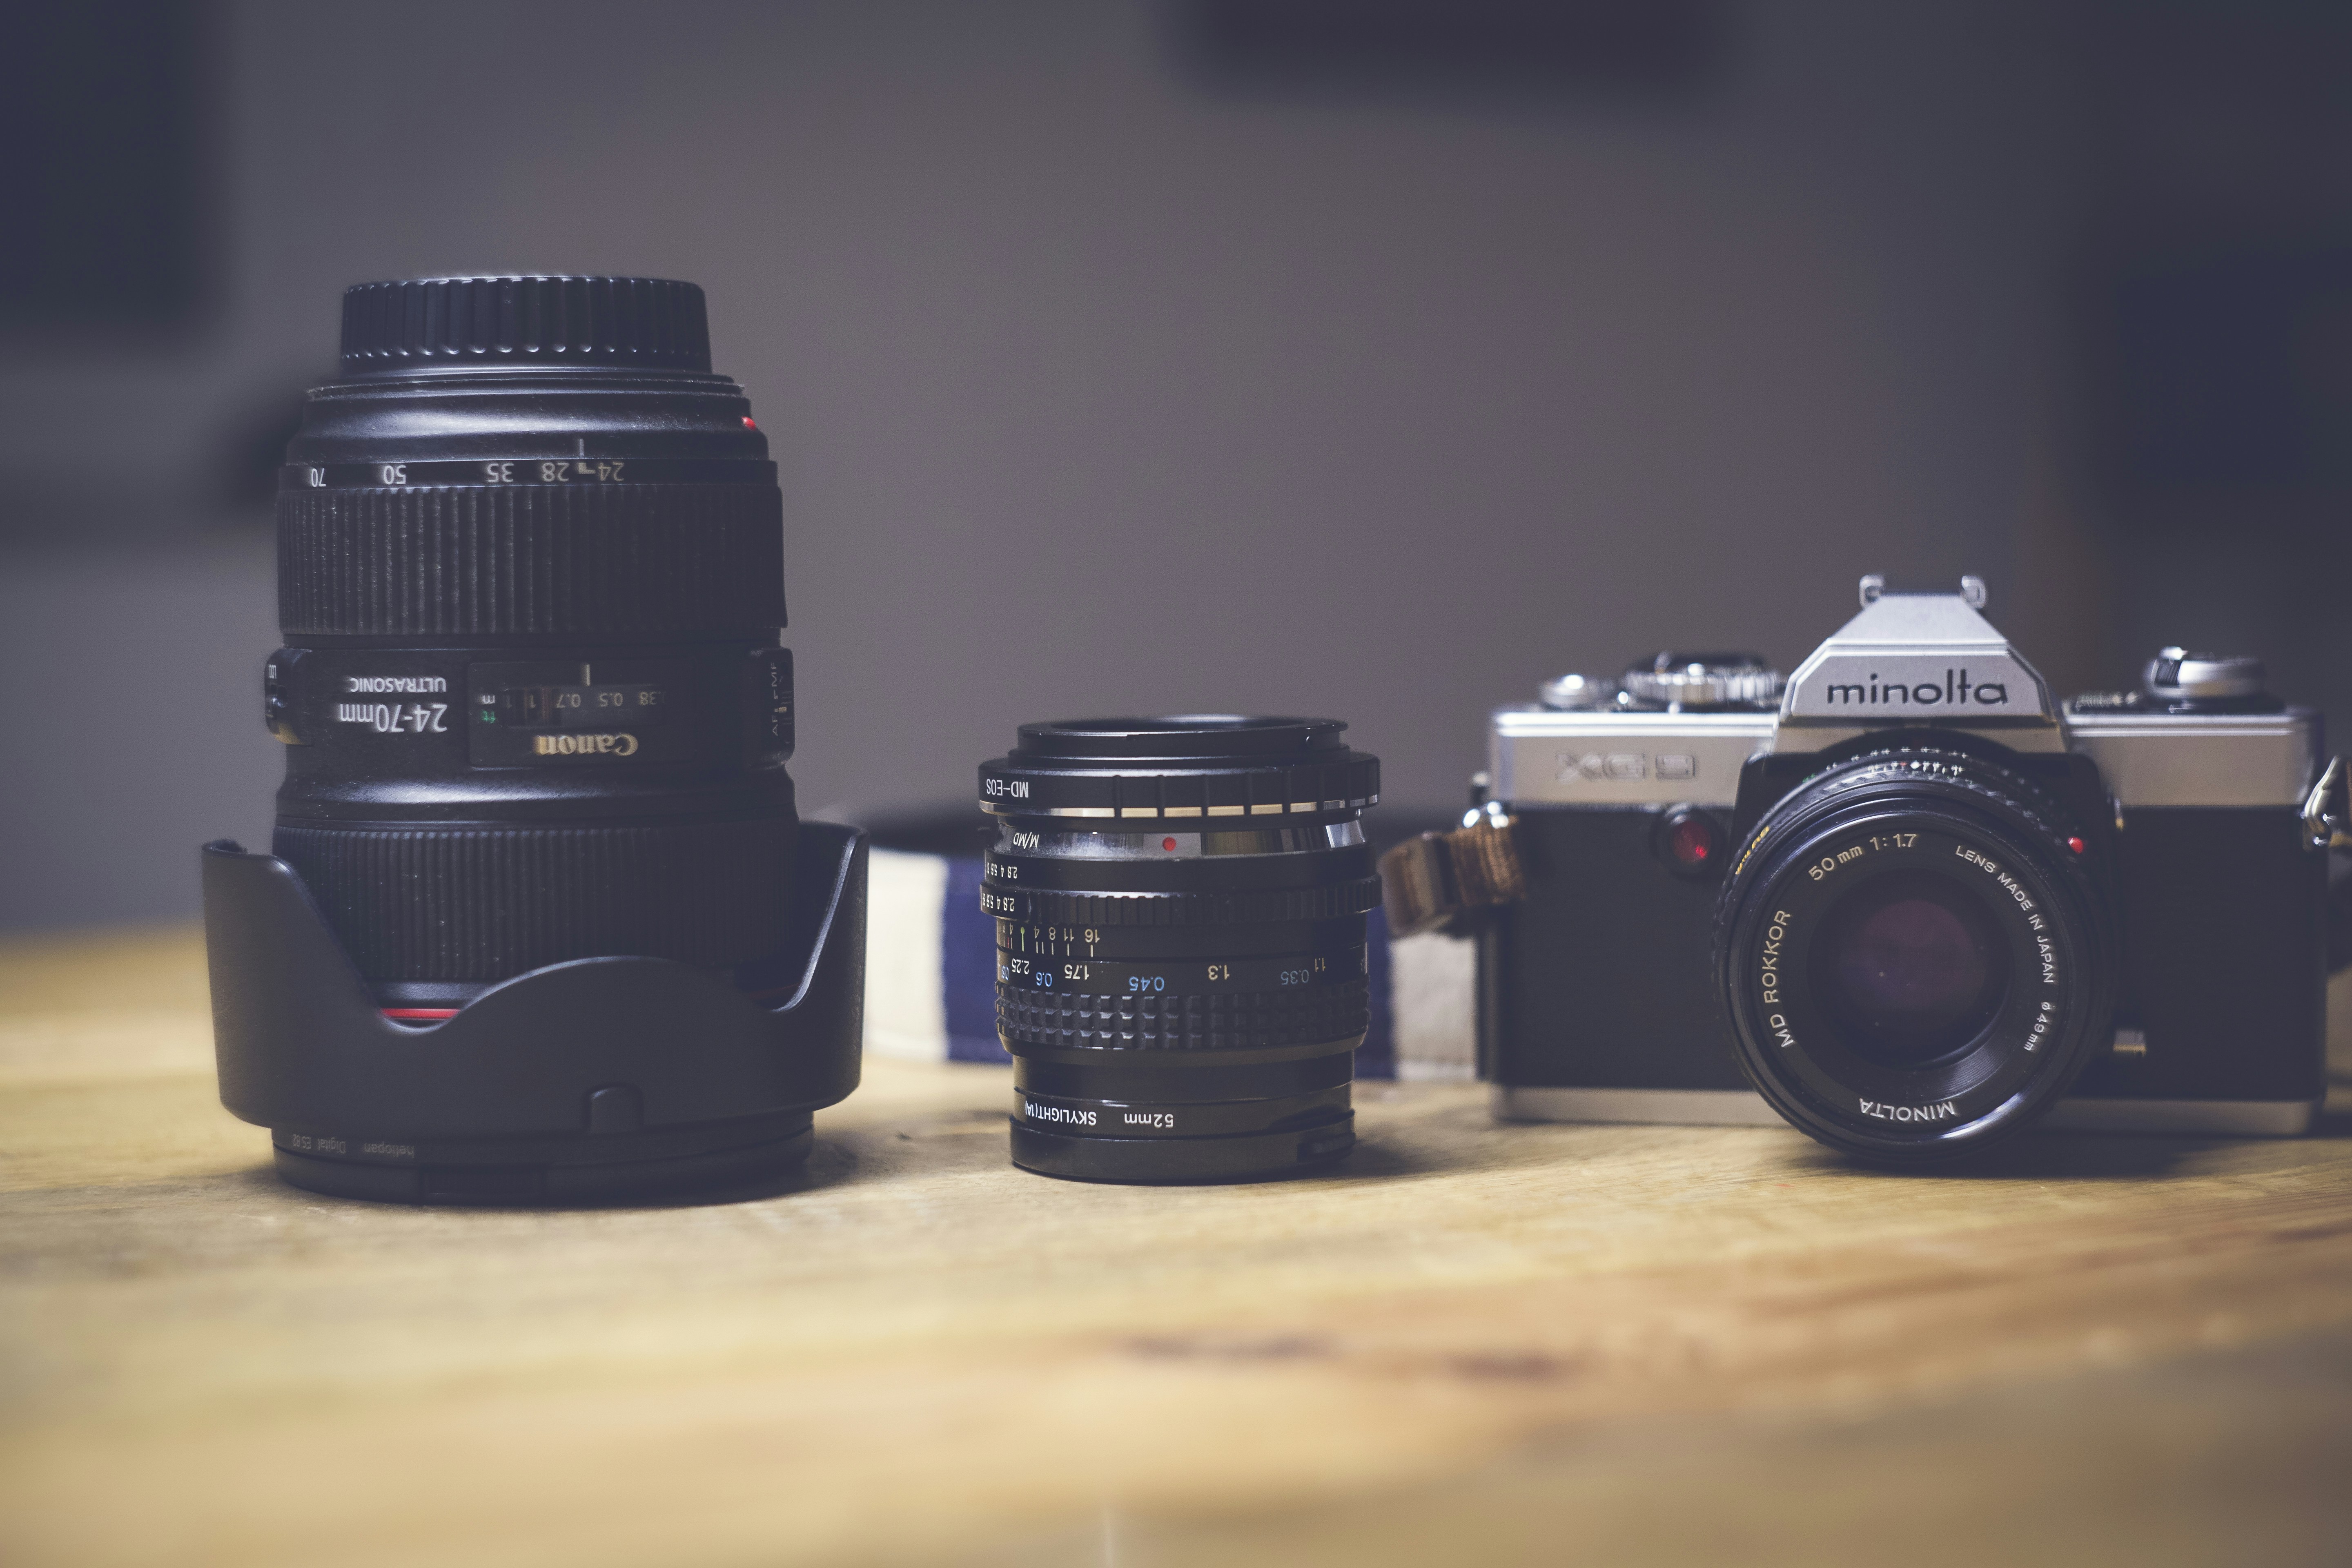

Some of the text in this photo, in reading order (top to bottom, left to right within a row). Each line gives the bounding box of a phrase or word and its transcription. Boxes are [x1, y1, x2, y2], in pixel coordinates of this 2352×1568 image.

[311, 462, 624, 488] 24 28 35 50 70
[771, 662, 778, 687] MF
[350, 677, 447, 693] ULTRASONIC
[1827, 668, 2008, 704] minolta
[482, 695, 495, 704] m
[556, 694, 581, 708] 0.7
[599, 692, 624, 707] 0.5
[340, 703, 448, 733] 24-70mm
[483, 710, 496, 723] ft
[771, 715, 778, 736] AF
[534, 733, 638, 756] Canon
[986, 778, 1029, 798] MD-EOS
[1013, 832, 1040, 849] M/MD
[1001, 864, 1004, 877] 4
[1007, 866, 1017, 879] 2.8
[997, 895, 1000, 910] 4
[1003, 897, 1014, 912] 2.8
[1955, 845, 2054, 983] LENS MADE IN JAPAN
[1009, 922, 1013, 935] 4
[1033, 926, 1040, 938] 4
[1049, 927, 1056, 940] 8
[1064, 928, 1074, 942] 11
[1085, 929, 1100, 943] 16
[1011, 958, 1030, 975] 2.25
[1064, 964, 1089, 980] 1.75
[1208, 964, 1230, 981] 1.3
[1314, 958, 1326, 972] 1.1
[1036, 971, 1052, 987] 0.6
[1129, 976, 1165, 991] 0.45
[1281, 969, 1310, 986] 0.35
[1762, 910, 1795, 1047] MD ROKKOR
[1859, 1098, 1955, 1121] MINOLTA
[1124, 1113, 1174, 1129] 52mm
[317, 1136, 346, 1154] Digital
[365, 1141, 415, 1158] heliopan
